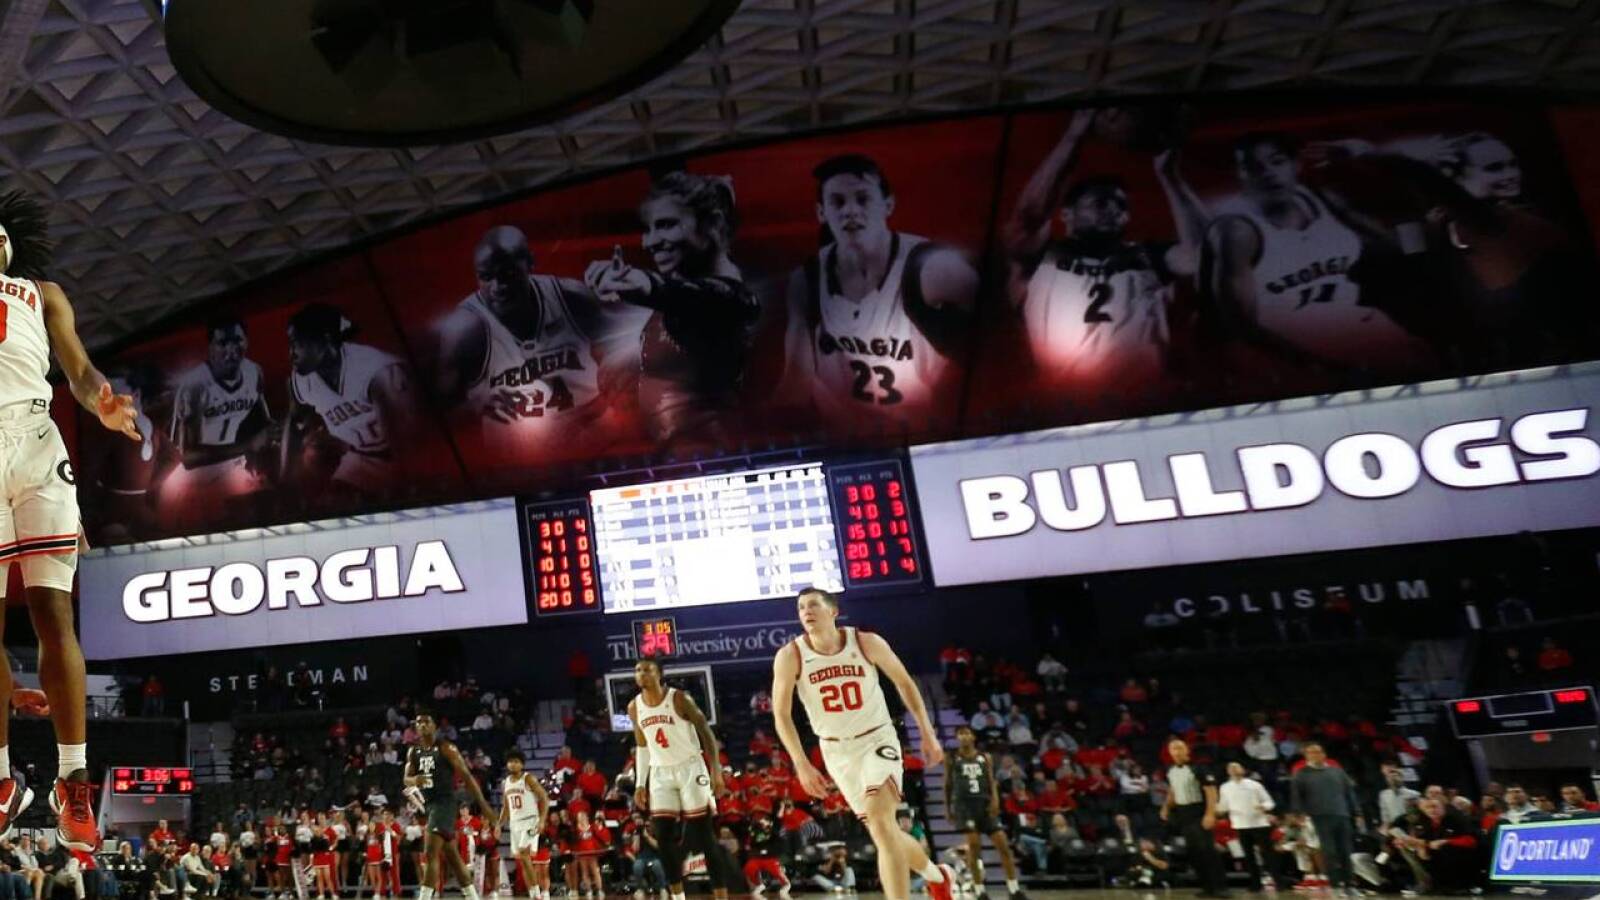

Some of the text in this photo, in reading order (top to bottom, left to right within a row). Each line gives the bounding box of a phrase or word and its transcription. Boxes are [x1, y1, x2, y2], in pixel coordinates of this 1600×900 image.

[1084, 282, 1114, 323] 2
[819, 332, 914, 361] GORGIA
[849, 360, 903, 405] 23
[218, 418, 231, 442] 1
[958, 407, 1600, 541] BULLDOGS
[860, 484, 875, 501] 0
[887, 481, 901, 498] 2
[864, 503, 879, 520] 0
[540, 519, 586, 538] 3 0 4
[868, 522, 883, 539] 0
[542, 540, 553, 554] 4
[578, 536, 589, 552] 0
[846, 542, 869, 560] 20
[541, 557, 555, 573] 10
[580, 553, 591, 569] 0
[122, 539, 466, 623] GEORGIA
[559, 573, 571, 589] 0
[581, 571, 593, 587] 5
[540, 592, 559, 609] 20
[562, 590, 573, 607] 0
[608, 640, 637, 661] Th
[677, 630, 743, 657] iversity
[745, 631, 763, 650] of
[209, 664, 369, 692] STEEMAN
[808, 665, 867, 685] GEORGIA
[819, 681, 865, 713] 20
[655, 727, 670, 749] 4
[1516, 837, 1591, 862] CORTLAND
